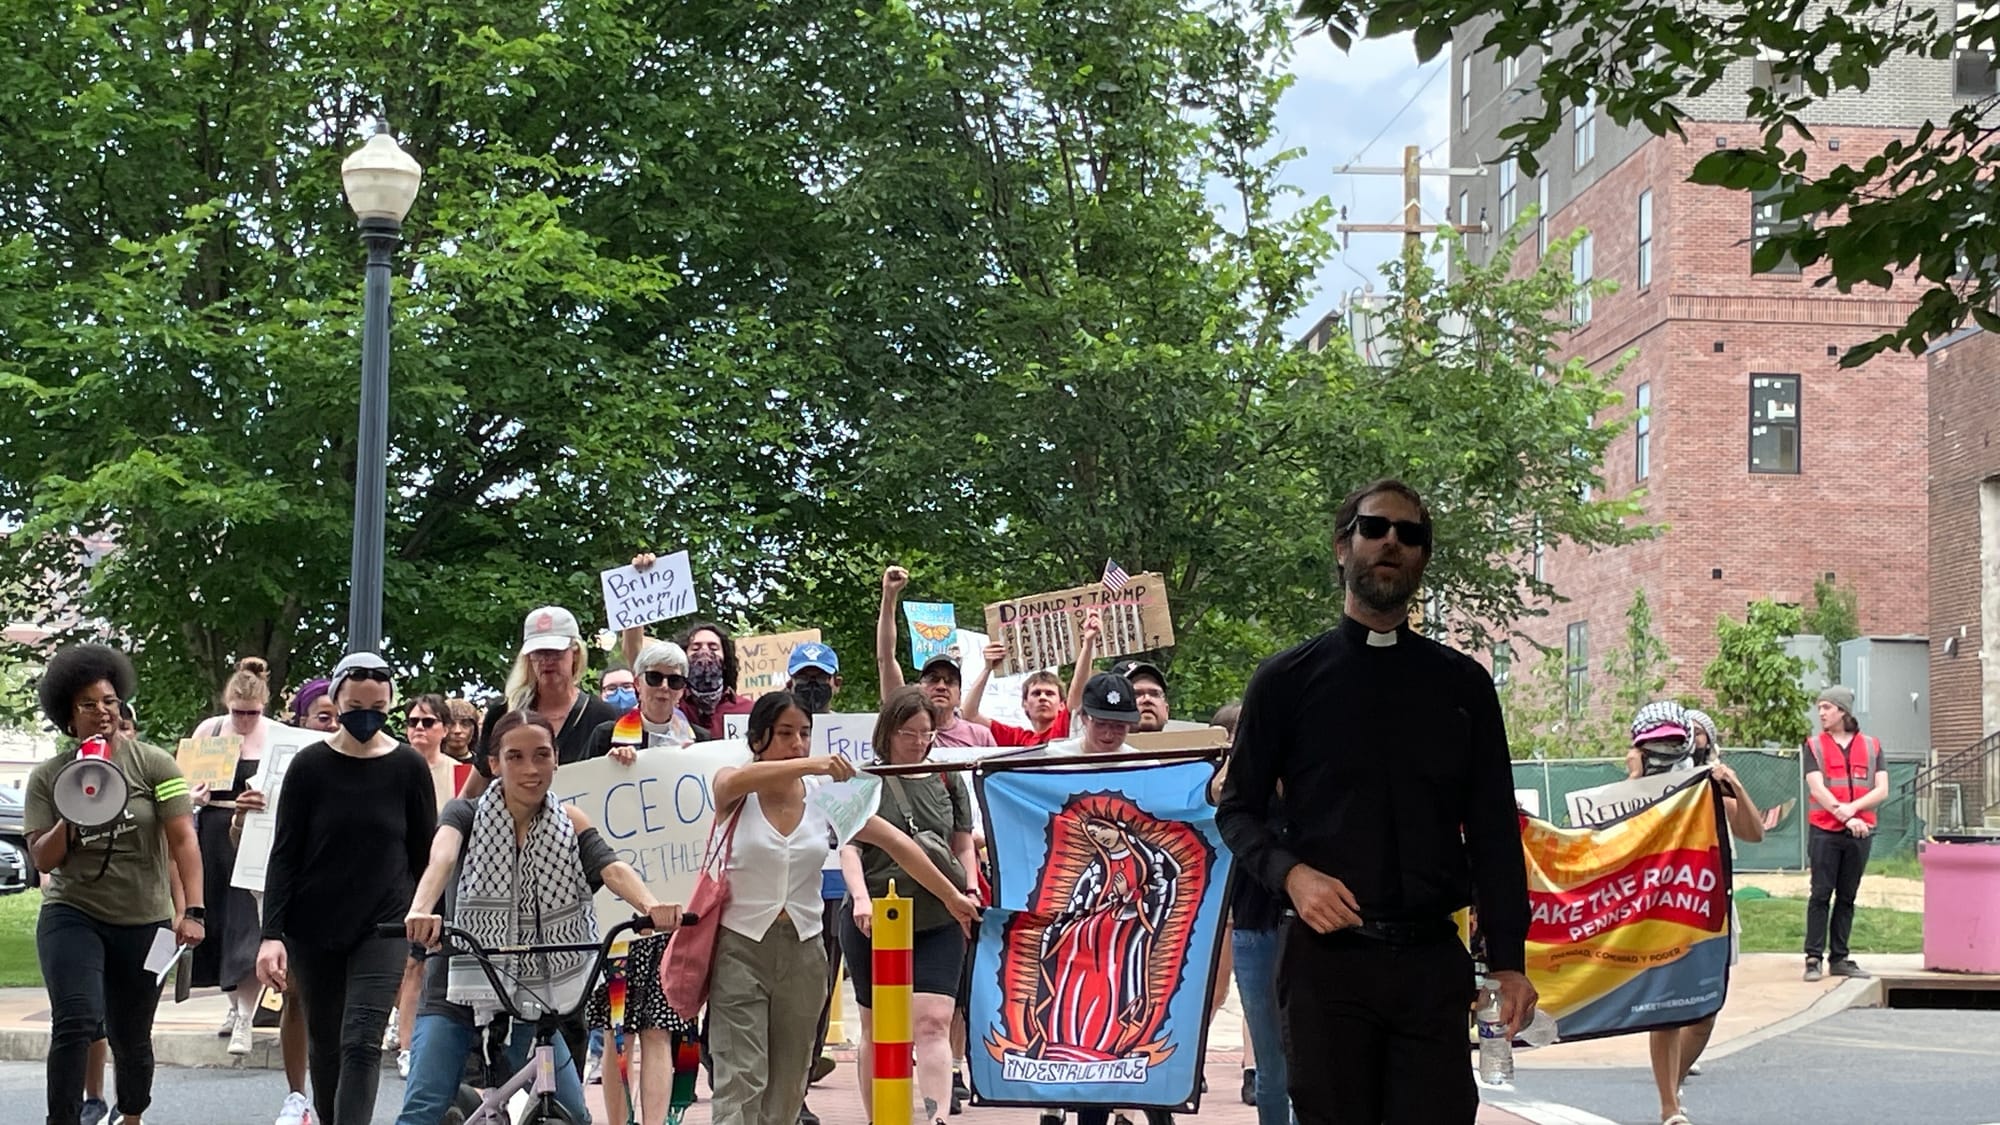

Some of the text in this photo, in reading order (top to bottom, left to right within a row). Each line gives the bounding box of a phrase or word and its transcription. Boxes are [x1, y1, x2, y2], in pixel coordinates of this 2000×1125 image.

[608, 569, 674, 599] Bring
[620, 591, 671, 611] Them
[1000, 598, 1066, 623] DONALD
[1088, 586, 1146, 606] TRUMP
[742, 640, 798, 658] WE W
[744, 658, 777, 674] NOT
[827, 726, 873, 762] FRIE
[1588, 874, 1637, 913] THE
[1643, 864, 1716, 893] ROAD
